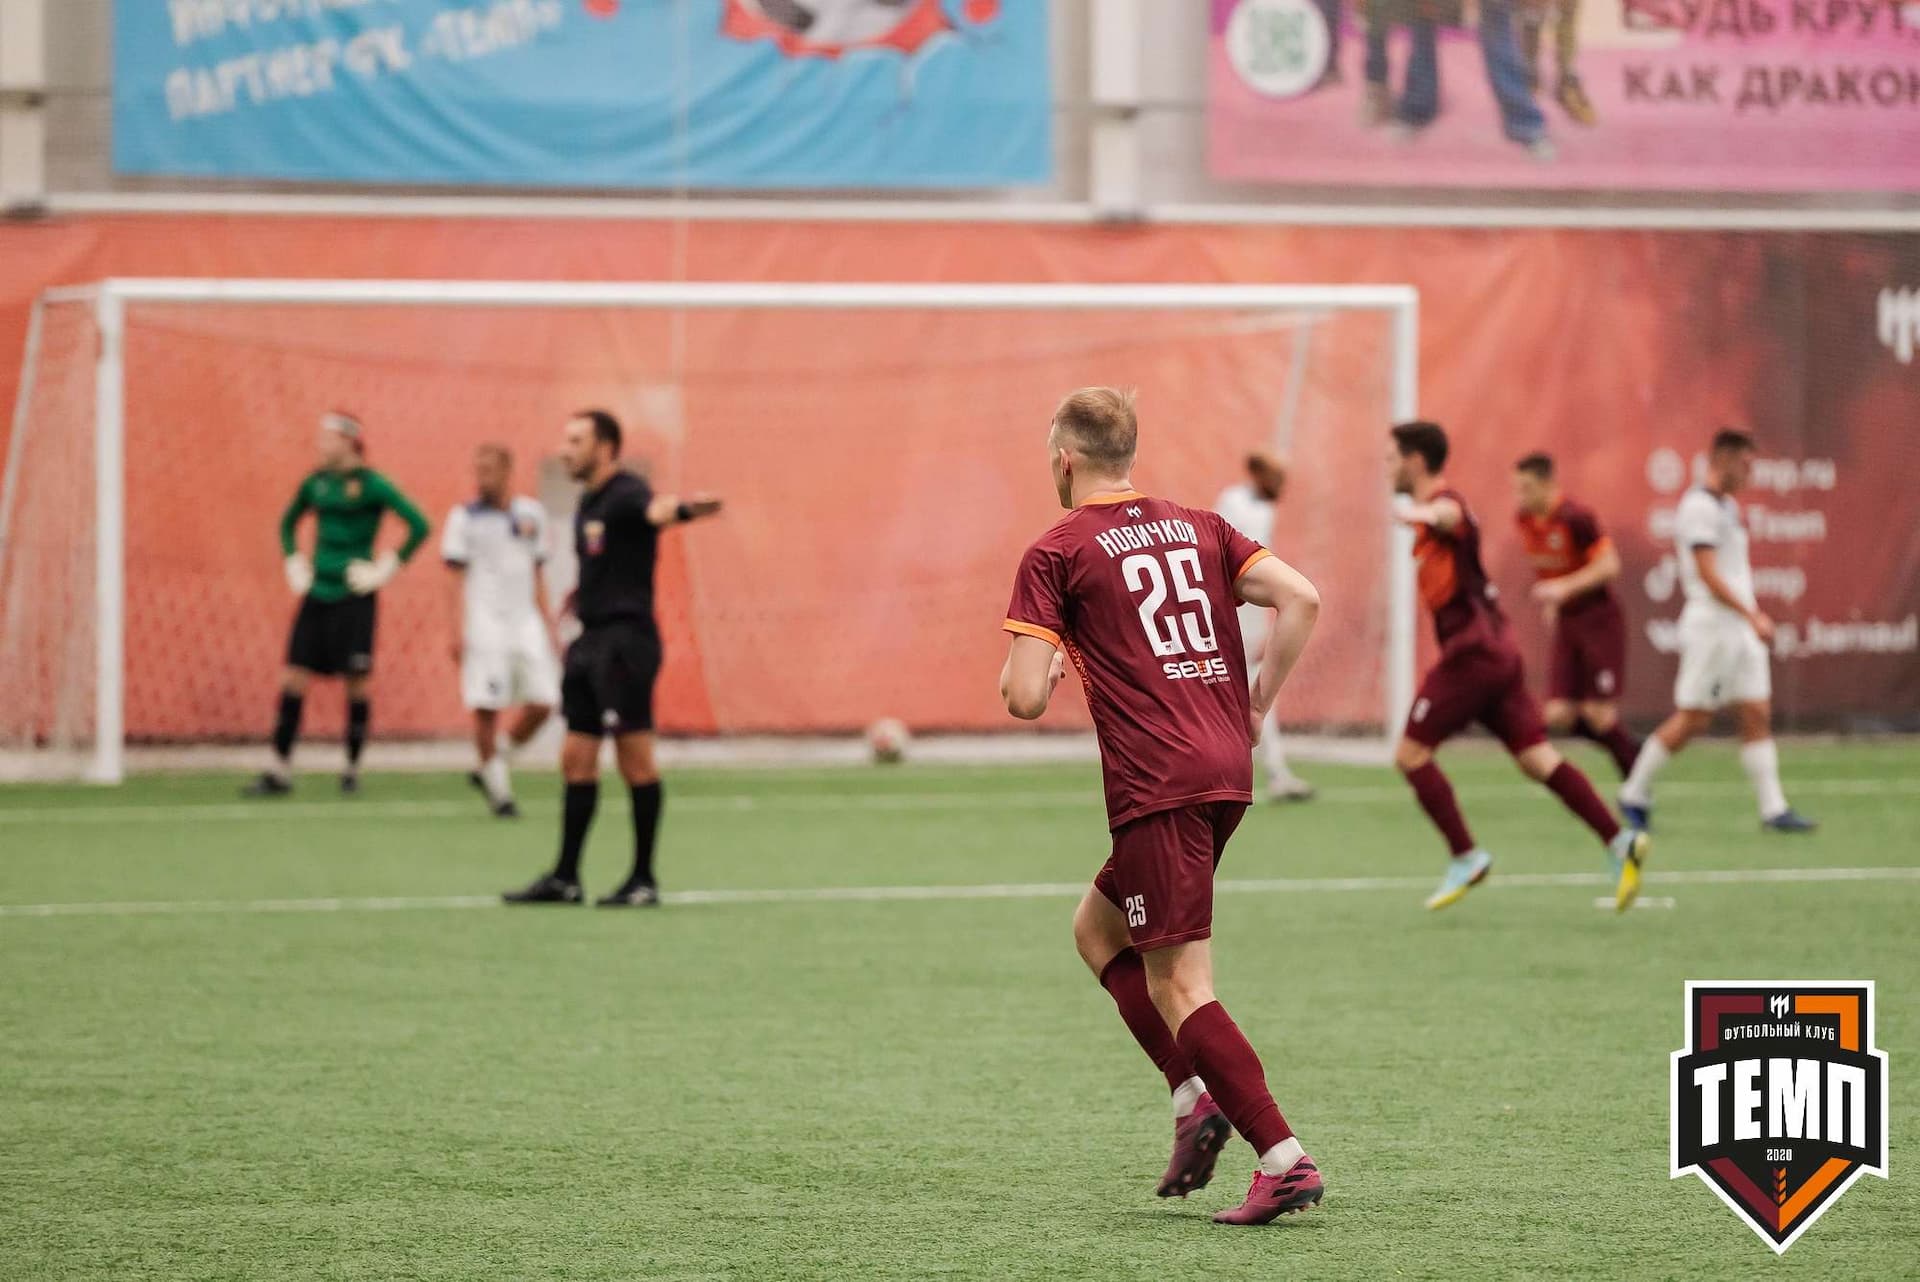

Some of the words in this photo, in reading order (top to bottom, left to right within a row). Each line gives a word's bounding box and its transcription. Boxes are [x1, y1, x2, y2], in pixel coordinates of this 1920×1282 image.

[1623, 65, 1719, 102] КАК
[1095, 519, 1199, 558] НОВИЧКОВ
[1121, 548, 1219, 657] 25
[1125, 894, 1147, 928] 25
